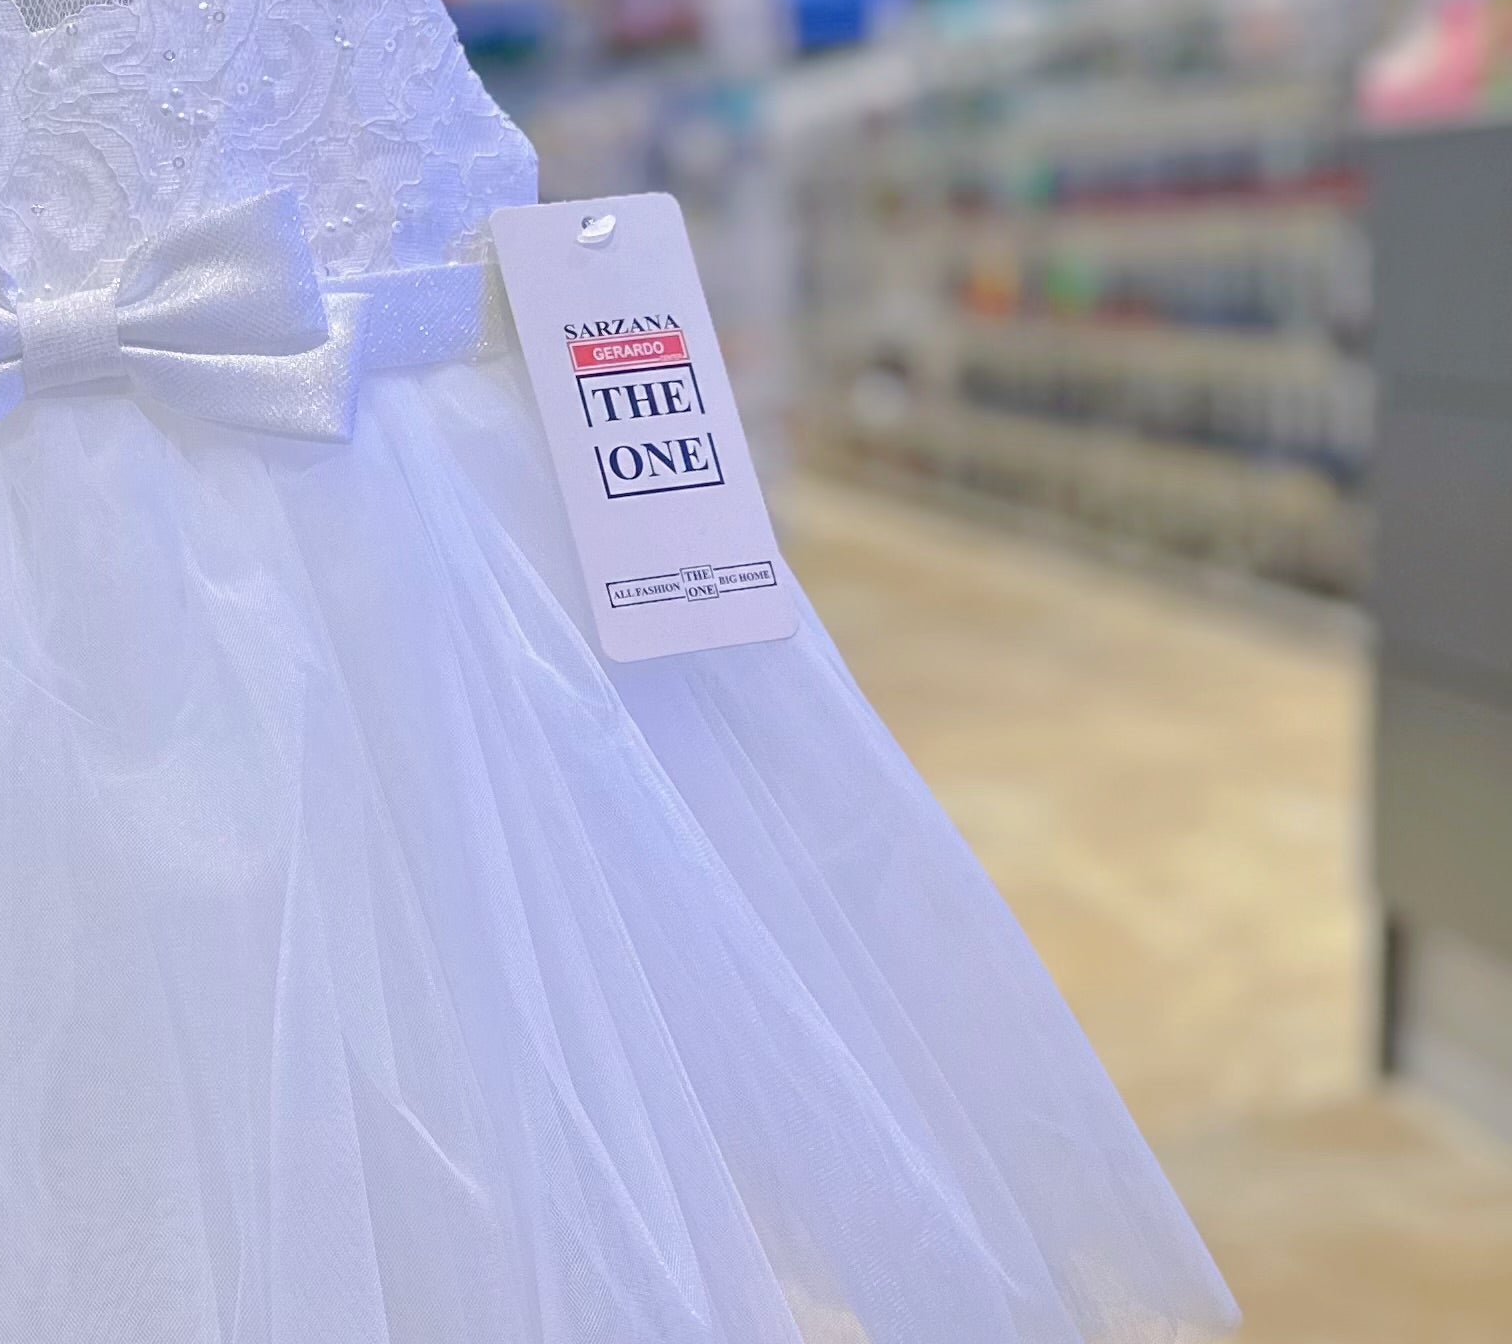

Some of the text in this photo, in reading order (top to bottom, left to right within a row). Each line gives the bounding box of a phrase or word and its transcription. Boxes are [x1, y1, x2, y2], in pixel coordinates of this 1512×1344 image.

[563, 314, 680, 340] SARZANA
[592, 341, 665, 361] GERARDO
[591, 379, 692, 422] THE
[609, 437, 709, 481] ONE
[684, 569, 713, 582] THE
[719, 569, 771, 585] BIG HOME
[613, 582, 681, 600] ALL FASHION
[688, 584, 716, 598] ONE
